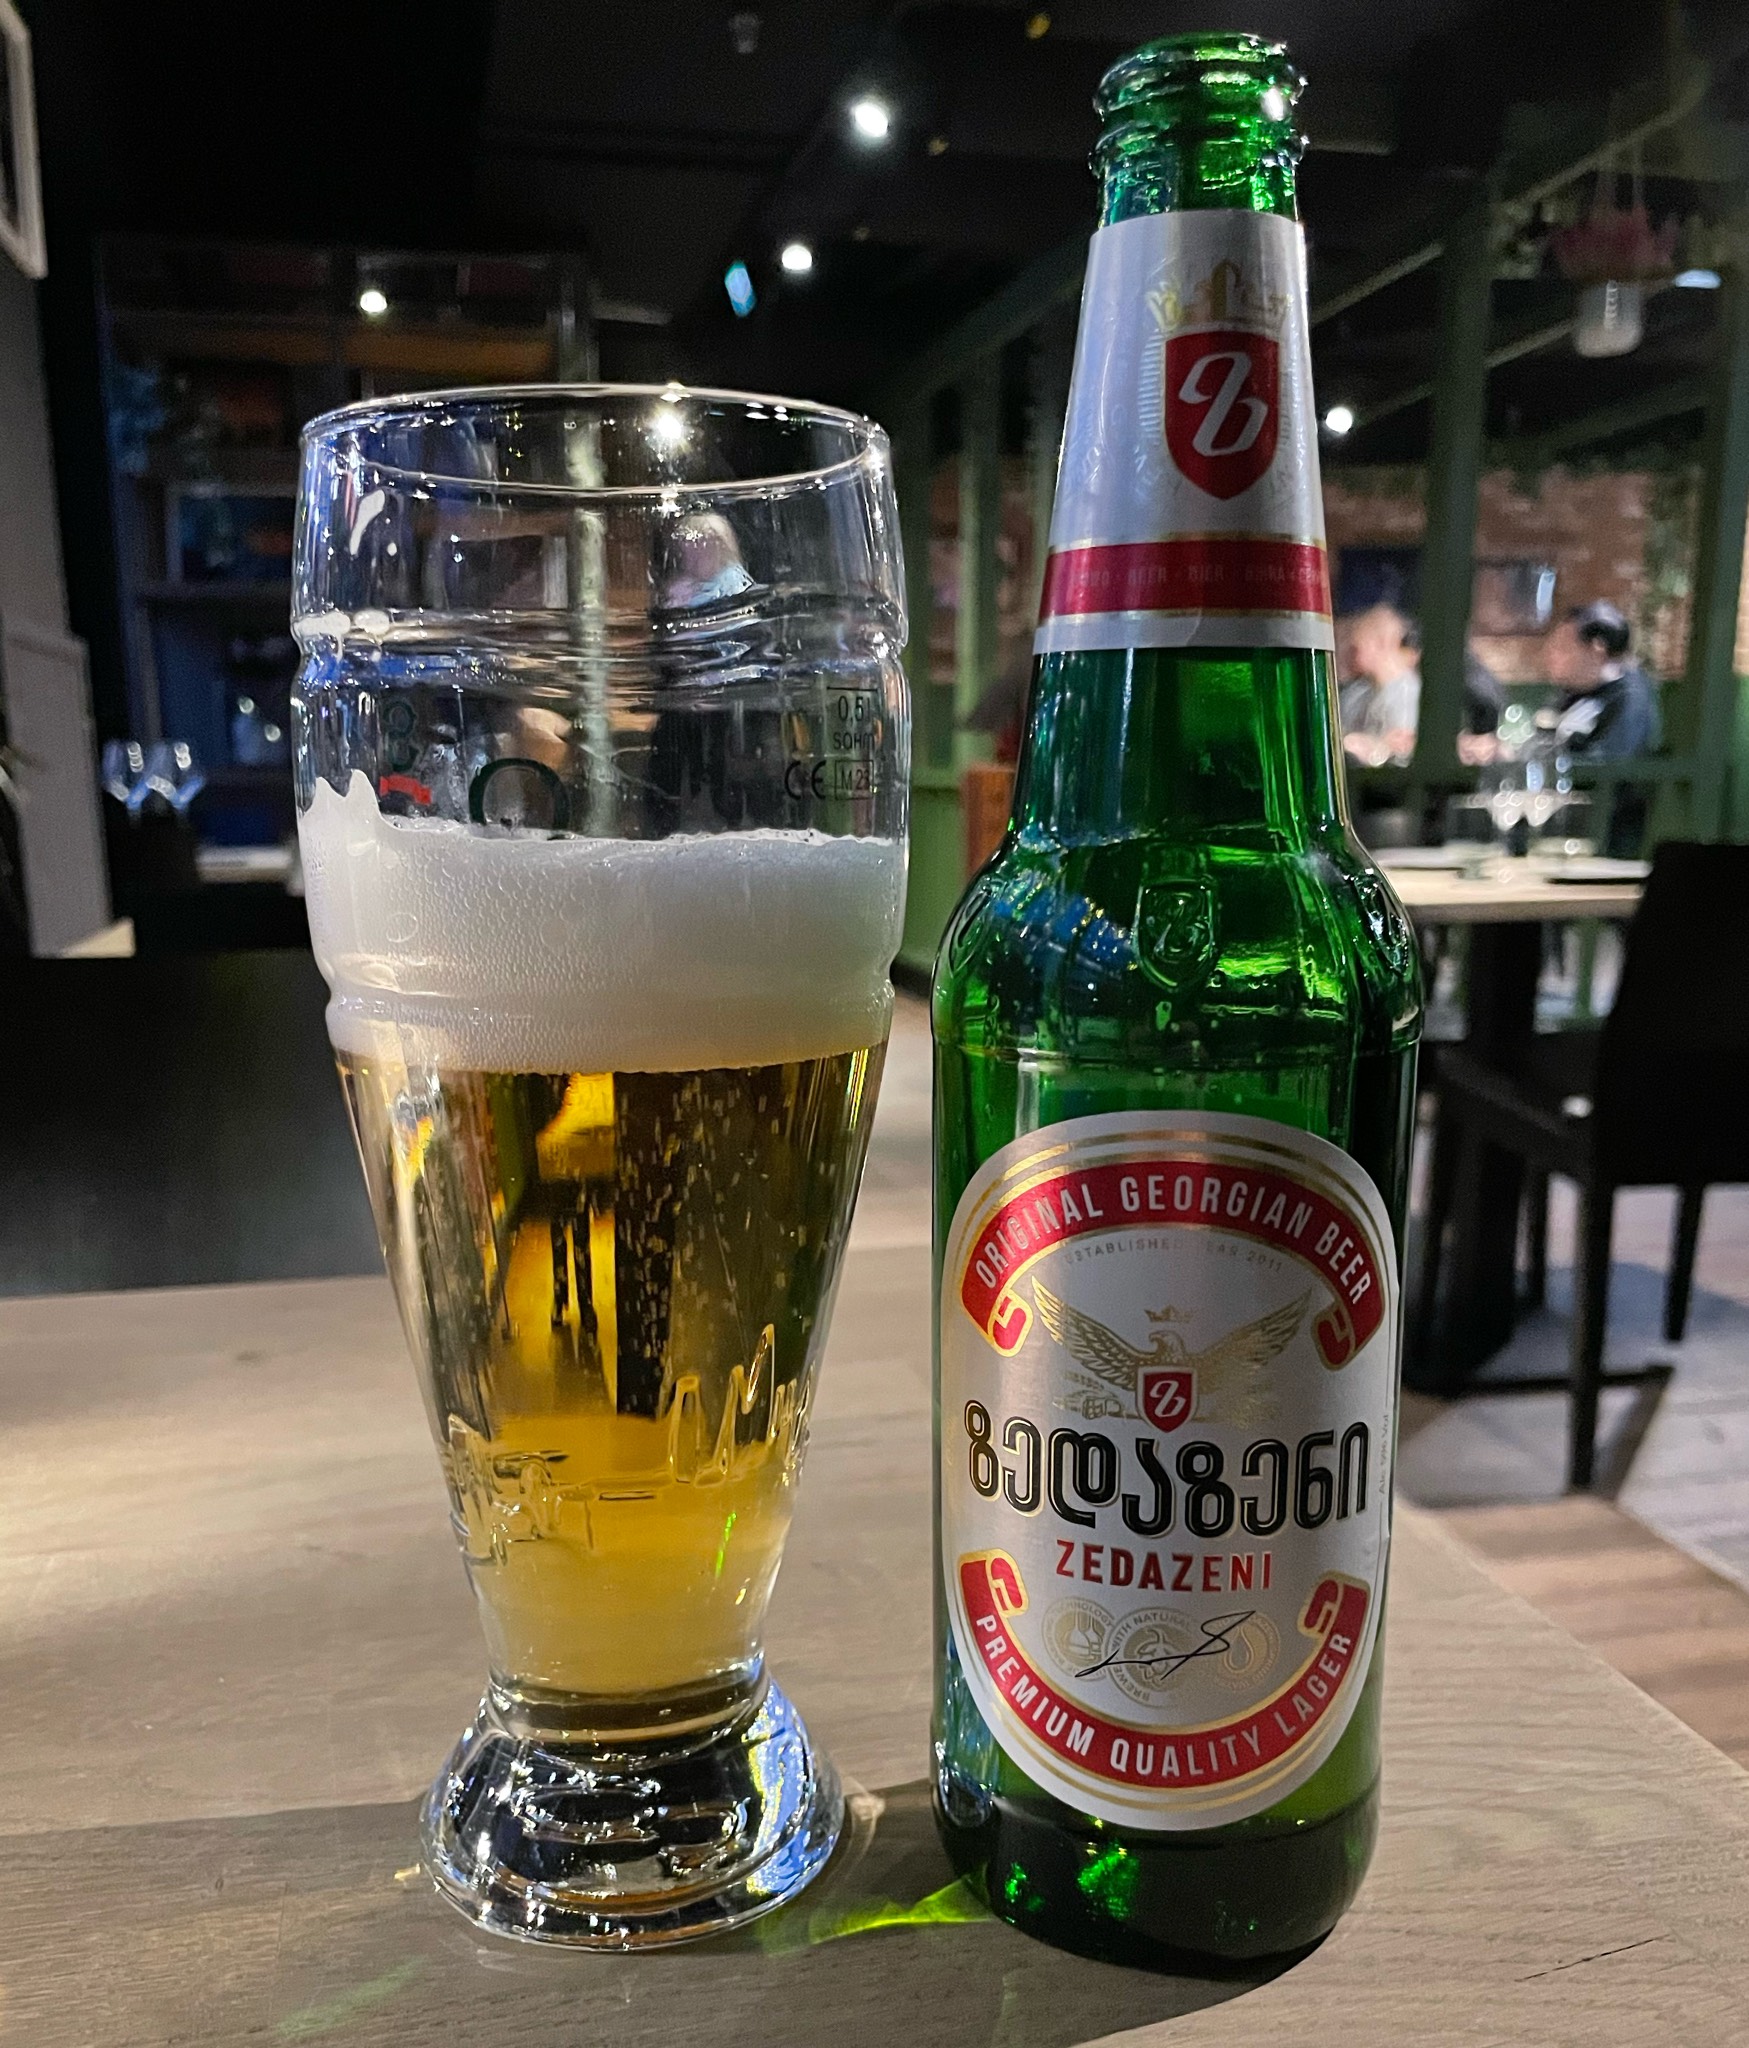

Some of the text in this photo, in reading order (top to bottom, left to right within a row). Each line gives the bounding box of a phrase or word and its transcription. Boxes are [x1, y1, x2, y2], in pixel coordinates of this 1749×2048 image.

[975, 1174, 1373, 1305] ORIGINAL GEORGIAN BEER
[1199, 1240, 1237, 1257] EAR
[963, 1399, 1371, 1538] ზედაზენი
[1055, 1538, 1273, 1594] ZEDAZENI
[976, 1613, 1095, 1757] PREMIUM
[1109, 1724, 1261, 1778] QUALITY
[1272, 1632, 1352, 1736] LAGER
[1112, 1656, 1151, 1702] BREWE
